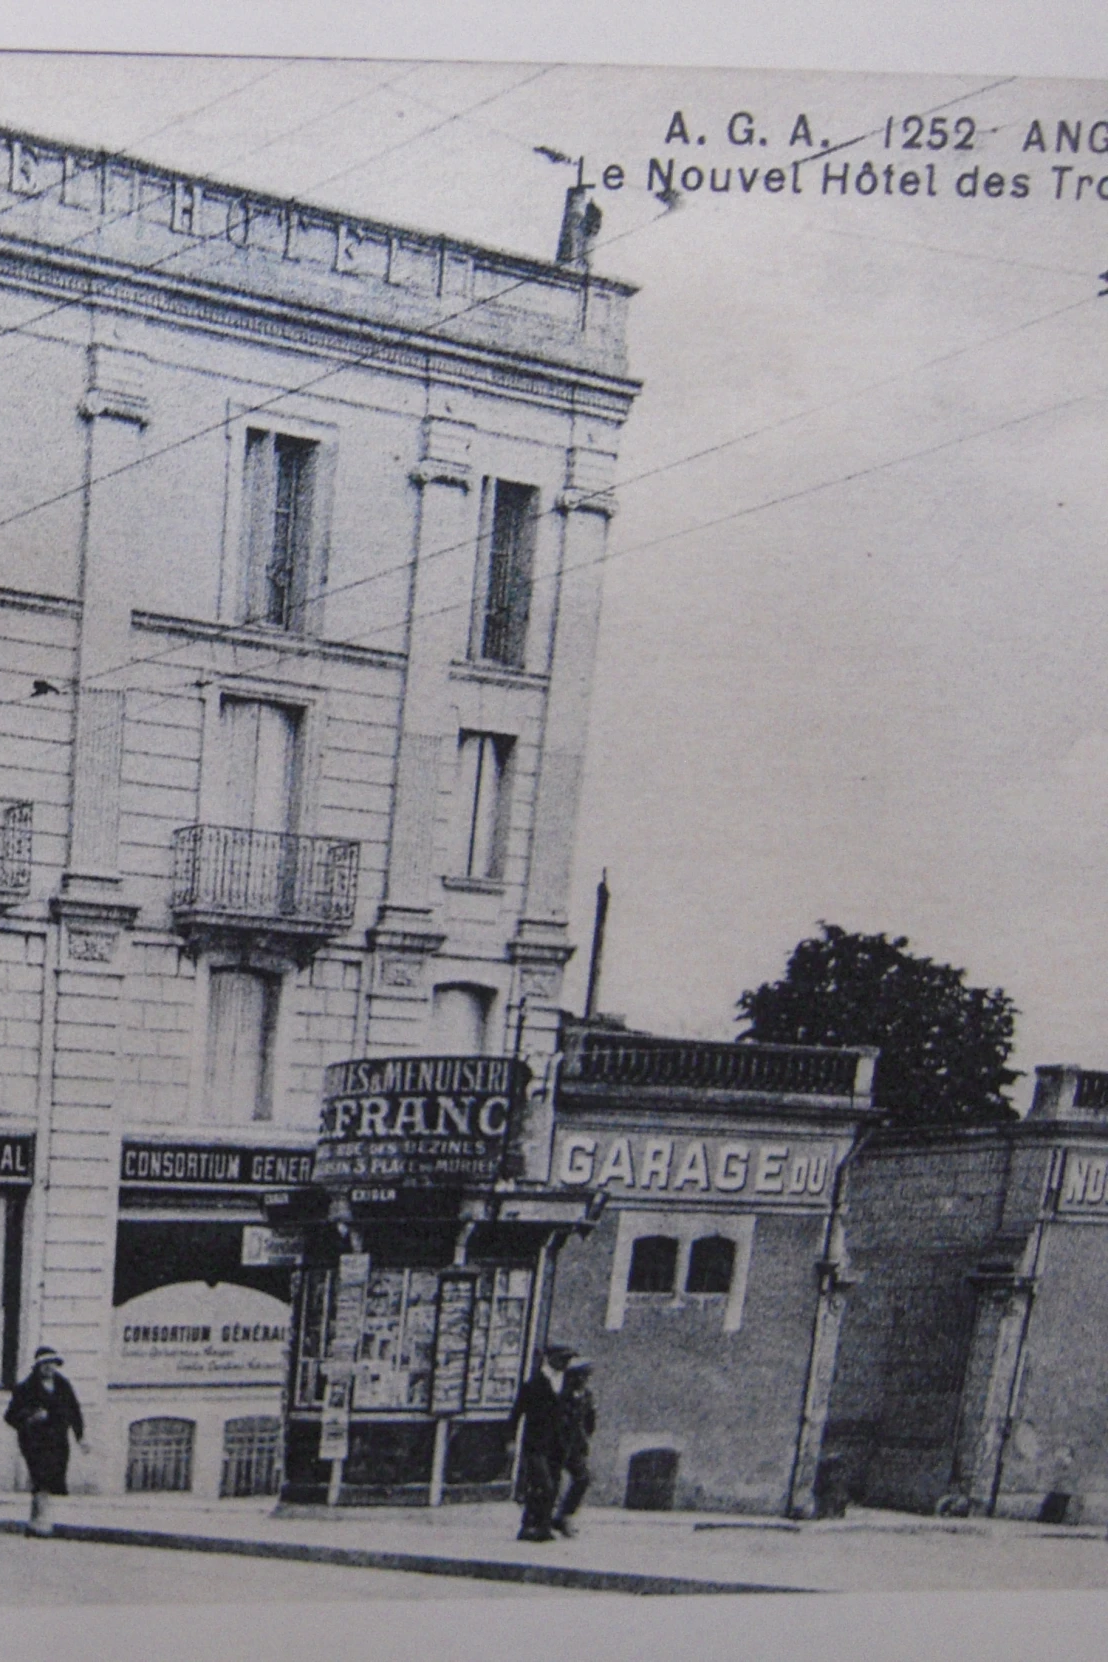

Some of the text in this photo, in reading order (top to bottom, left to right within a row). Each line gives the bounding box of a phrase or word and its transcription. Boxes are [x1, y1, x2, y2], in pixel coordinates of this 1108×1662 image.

[125, 1150, 241, 1179] CONSORTIUM
[559, 1134, 829, 1196] GARAGE DU
[123, 1325, 212, 1342] CONSORTIUM
